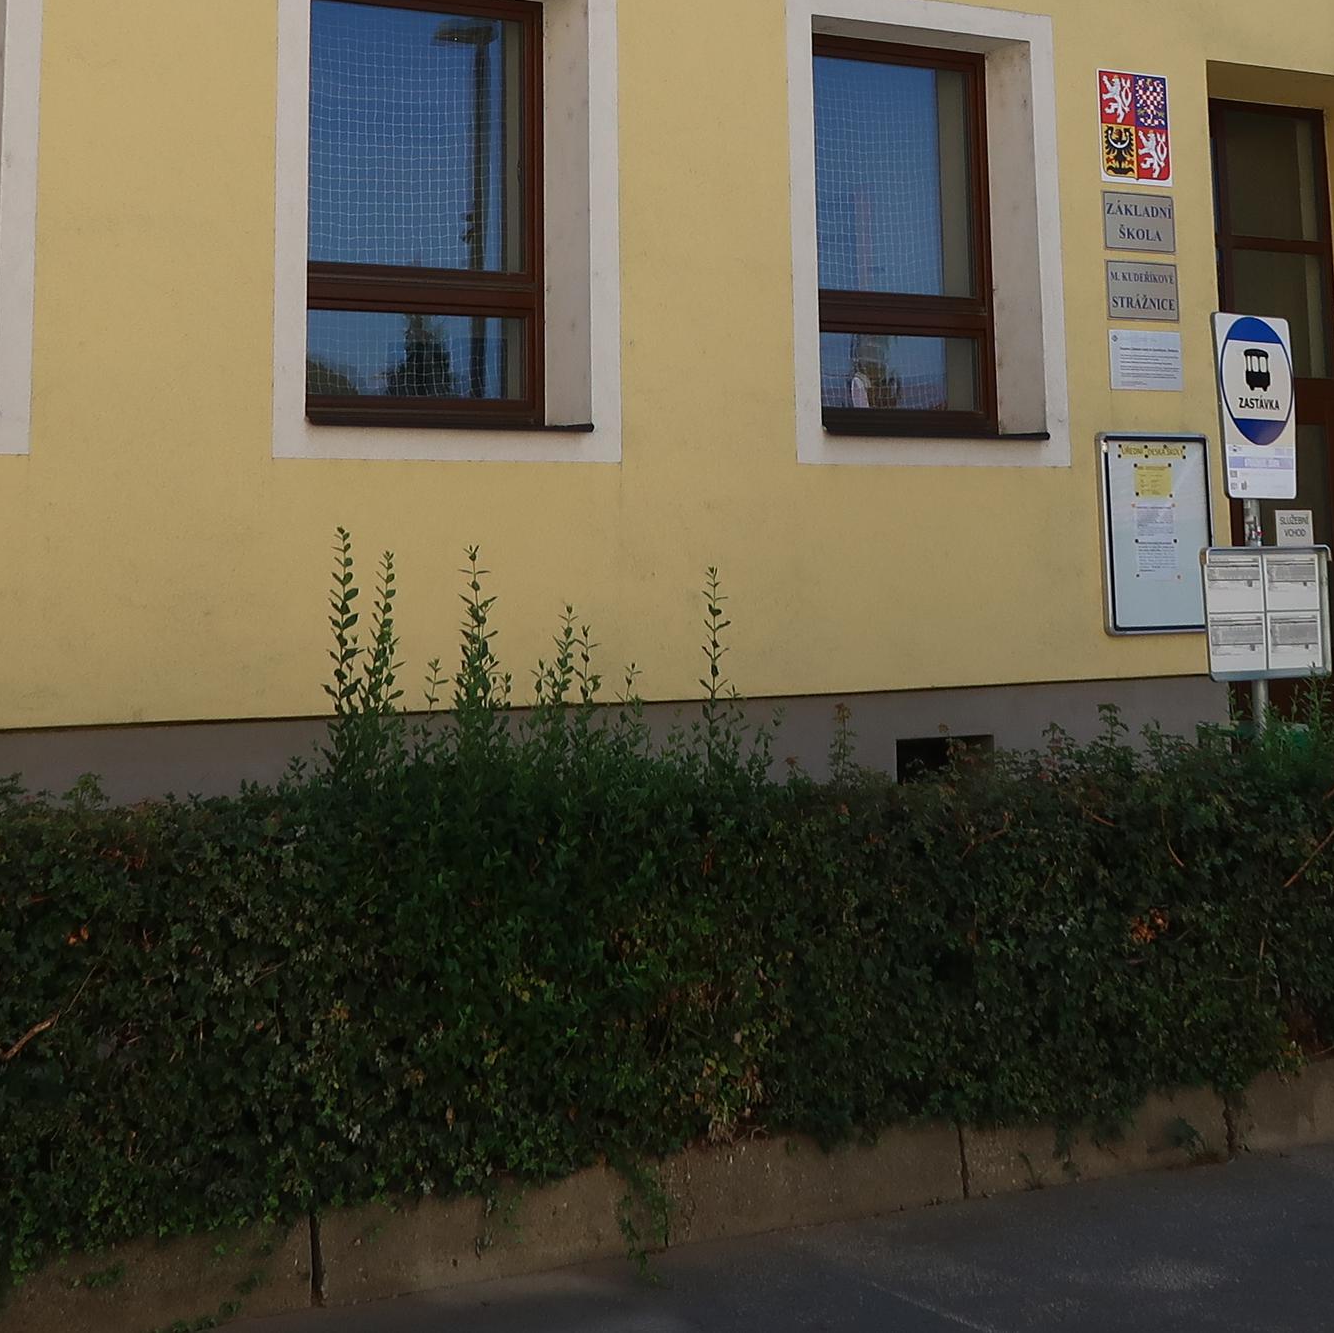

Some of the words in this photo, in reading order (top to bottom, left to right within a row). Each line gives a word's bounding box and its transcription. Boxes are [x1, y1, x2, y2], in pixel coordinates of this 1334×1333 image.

[1106, 200, 1172, 219] ZÁKLADNÍ
[1119, 224, 1162, 241] ŠKOLA
[1112, 294, 1175, 311] STRÁŽNICE
[1238, 395, 1280, 410] ZASTÁVKA
